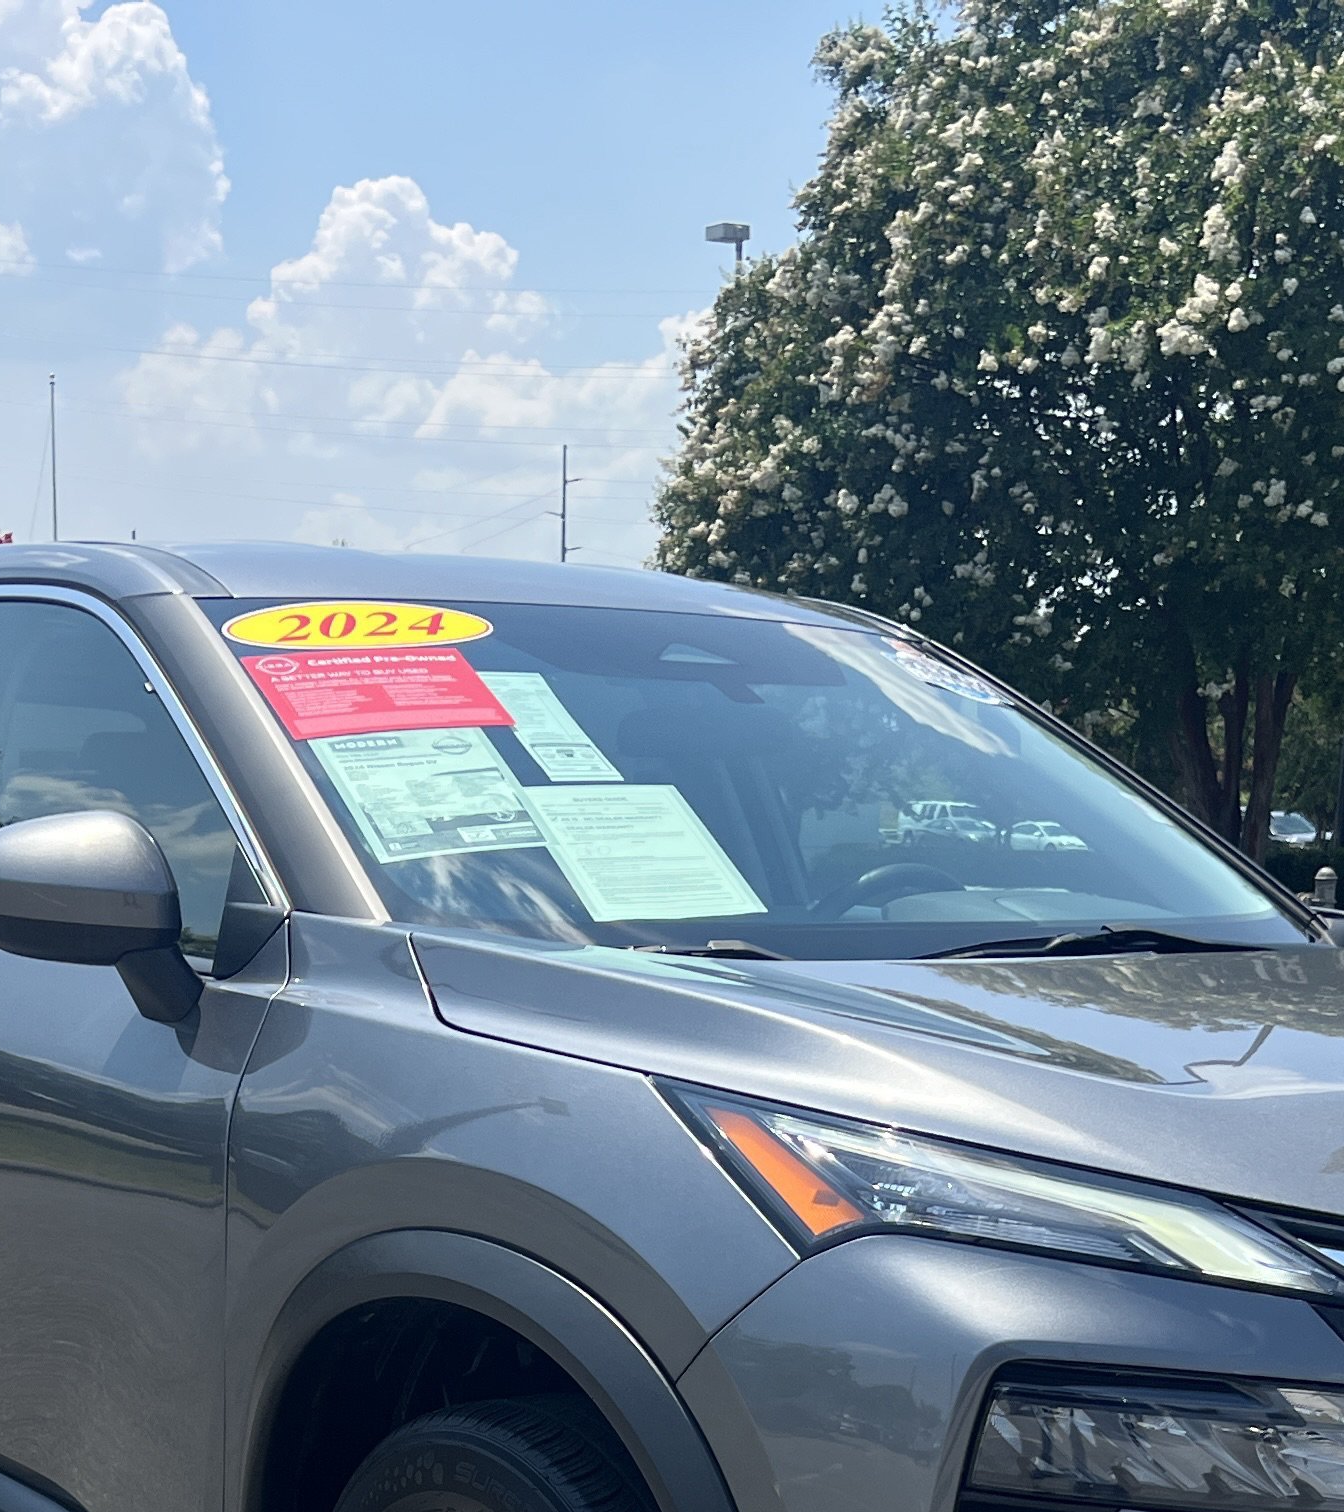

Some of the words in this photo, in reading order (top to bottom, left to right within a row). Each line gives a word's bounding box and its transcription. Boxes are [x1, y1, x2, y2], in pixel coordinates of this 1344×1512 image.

[276, 611, 445, 642] 2024
[307, 655, 371, 667] Certified
[373, 654, 457, 663] Pre-Owned
[281, 672, 325, 682] BETTER
[354, 669, 371, 677] TO
[335, 737, 398, 750] MODERN
